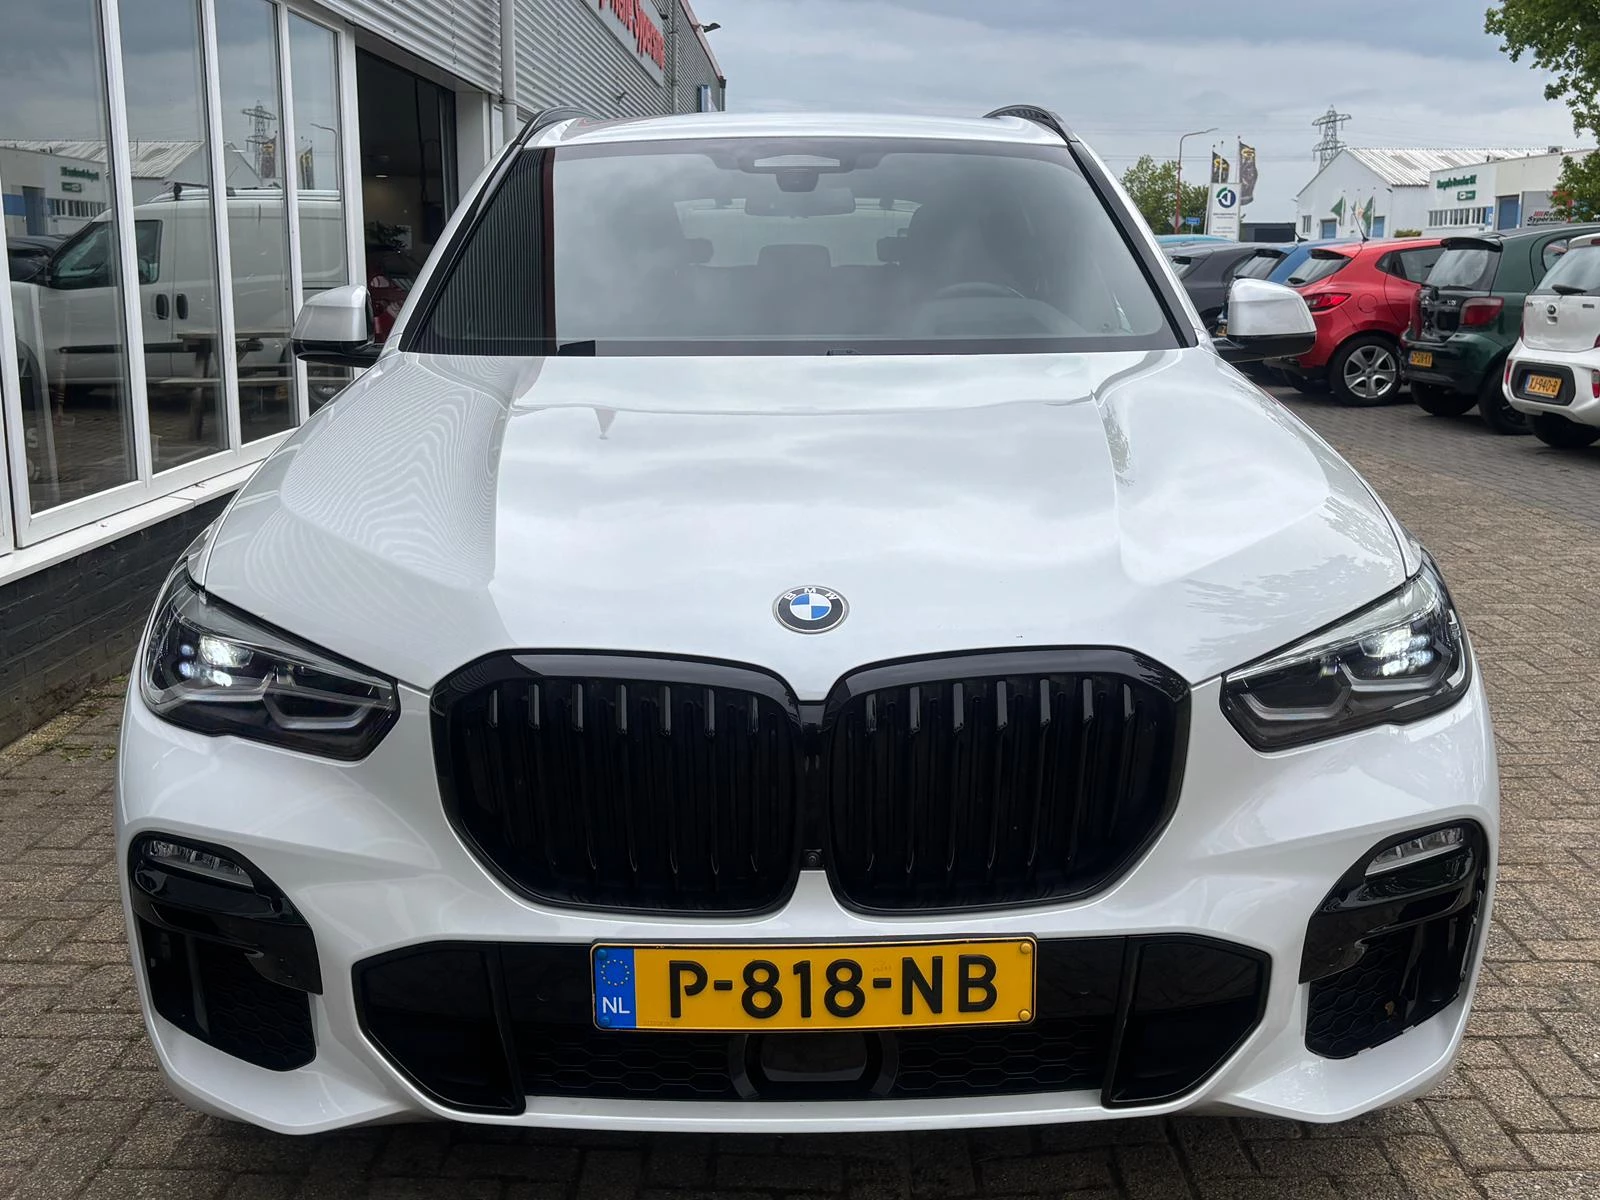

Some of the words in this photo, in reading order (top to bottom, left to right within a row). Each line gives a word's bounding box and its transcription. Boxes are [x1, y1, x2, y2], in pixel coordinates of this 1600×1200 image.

[783, 588, 839, 600] BMW
[668, 954, 998, 1019] P-818-NB
[602, 997, 630, 1015] NL
